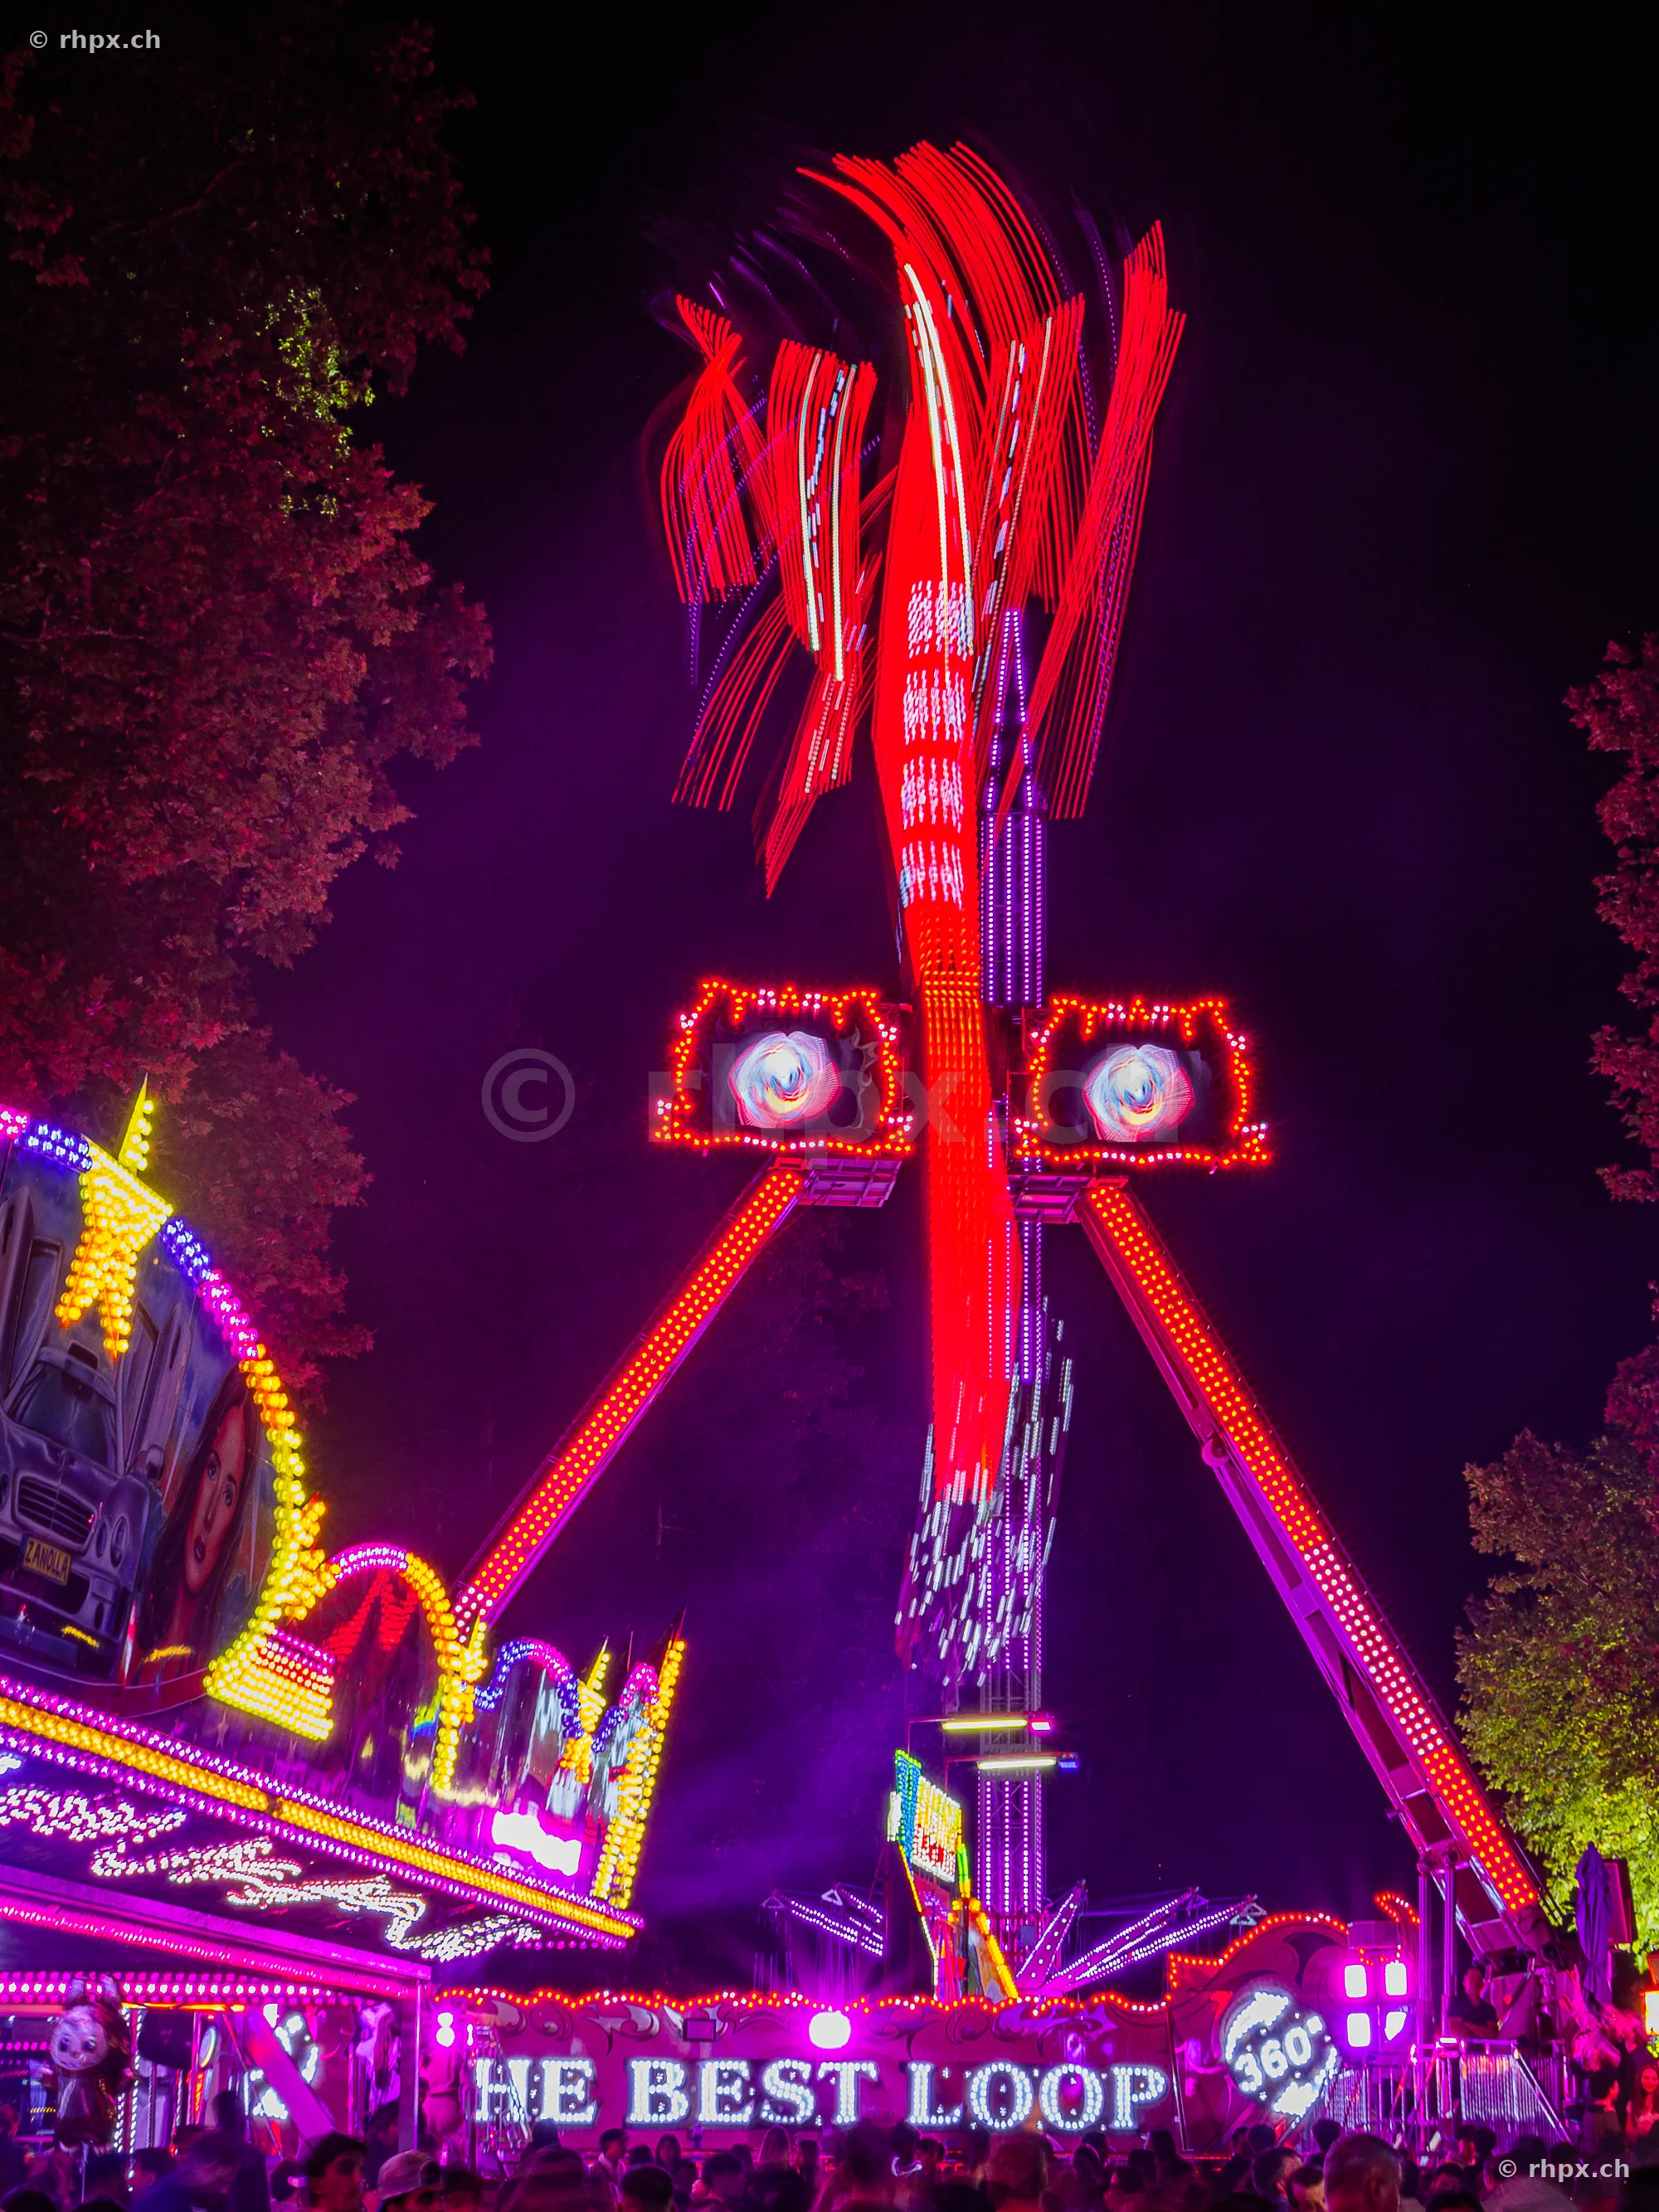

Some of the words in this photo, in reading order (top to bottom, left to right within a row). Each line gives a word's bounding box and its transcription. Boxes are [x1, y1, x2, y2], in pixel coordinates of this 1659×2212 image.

[475, 2059, 596, 2123] HE
[628, 2058, 878, 2125] BEST
[906, 2060, 1168, 2132] LOOP
